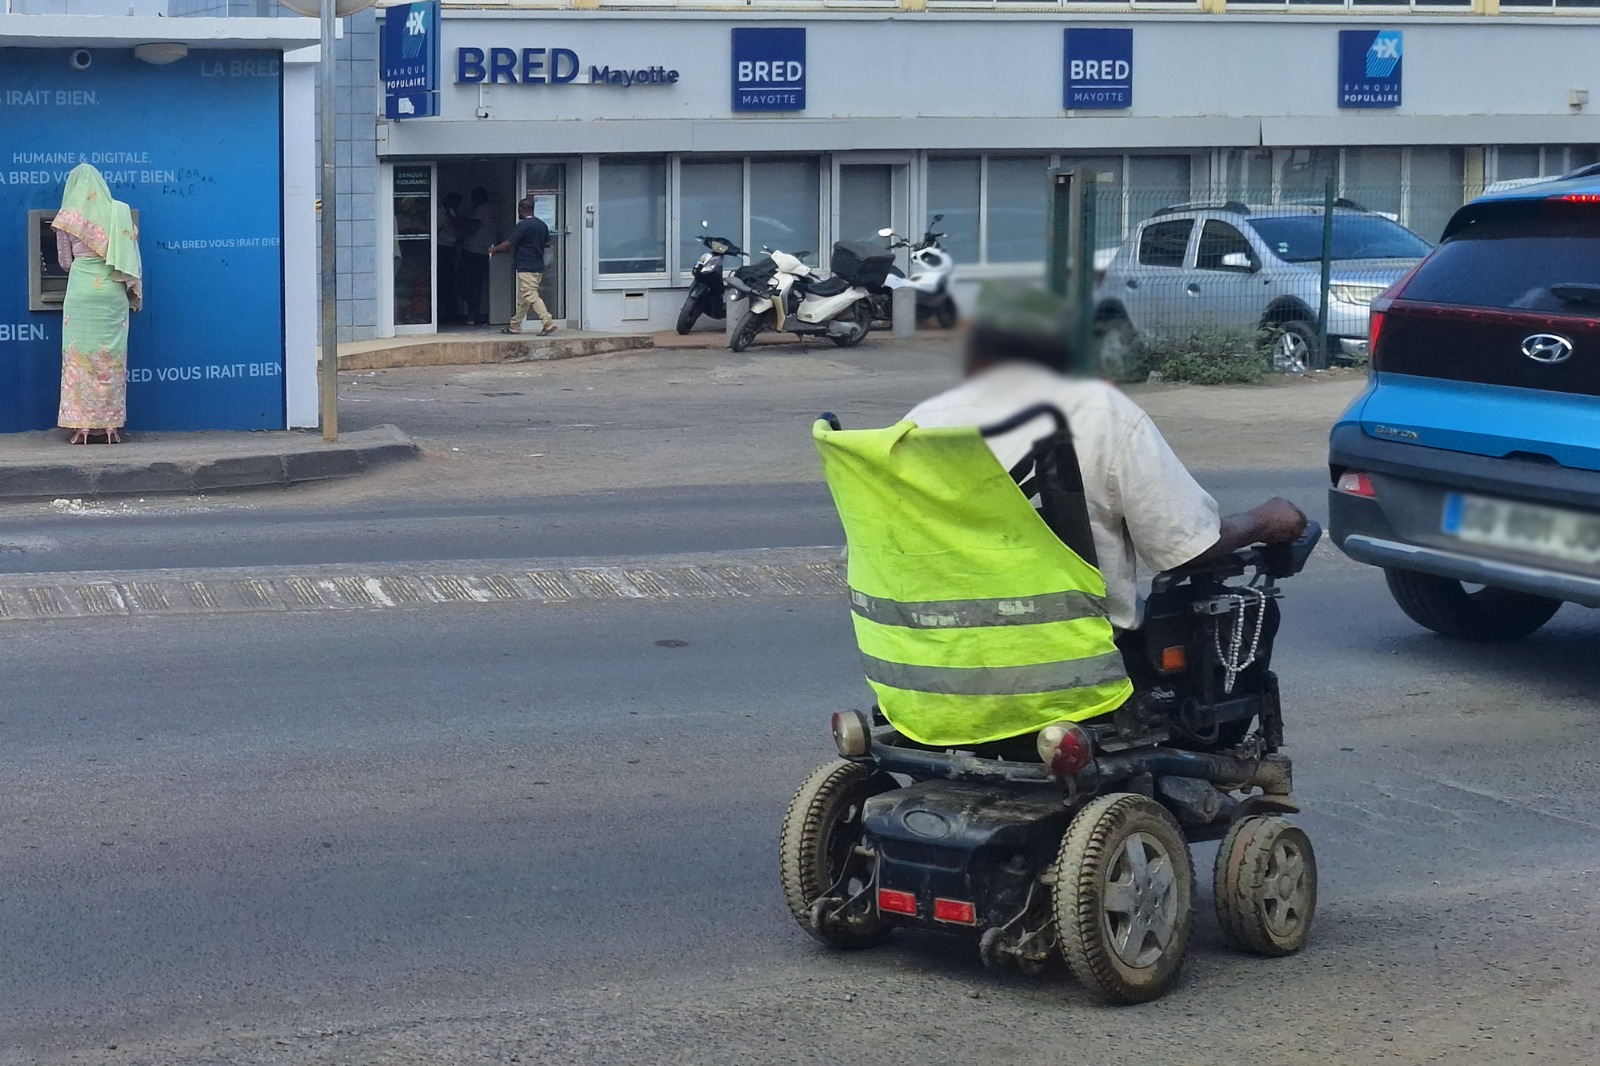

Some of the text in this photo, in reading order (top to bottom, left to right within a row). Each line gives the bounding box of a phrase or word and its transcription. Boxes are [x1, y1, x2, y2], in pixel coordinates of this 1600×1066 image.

[201, 60, 279, 77] LA BRED
[387, 64, 425, 77] BANQUE
[455, 47, 680, 88] BRED Mayotte
[738, 61, 802, 82] BRED
[1070, 60, 1130, 80] BRED
[387, 77, 426, 90] POPULAIRE
[1344, 83, 1398, 92] BANQUE
[6, 90, 100, 105] IRAIT BIEN.
[742, 95, 797, 105] MAYOTTE
[1074, 92, 1124, 102] MAYOTTE
[1344, 94, 1399, 102] POPULAIRE
[13, 152, 152, 164] HUMAINE & DIGITALE,
[9, 171, 50, 184] BRED
[141, 169, 178, 183] BIEN.
[168, 240, 180, 250] LA
[182, 239, 207, 249] BRED
[209, 239, 235, 248] VOUS
[237, 238, 260, 247] IRAIT
[0, 323, 49, 341] BIEN.
[125, 368, 152, 383] RED
[157, 366, 201, 382] VOUS
[206, 364, 246, 379] IRAIT
